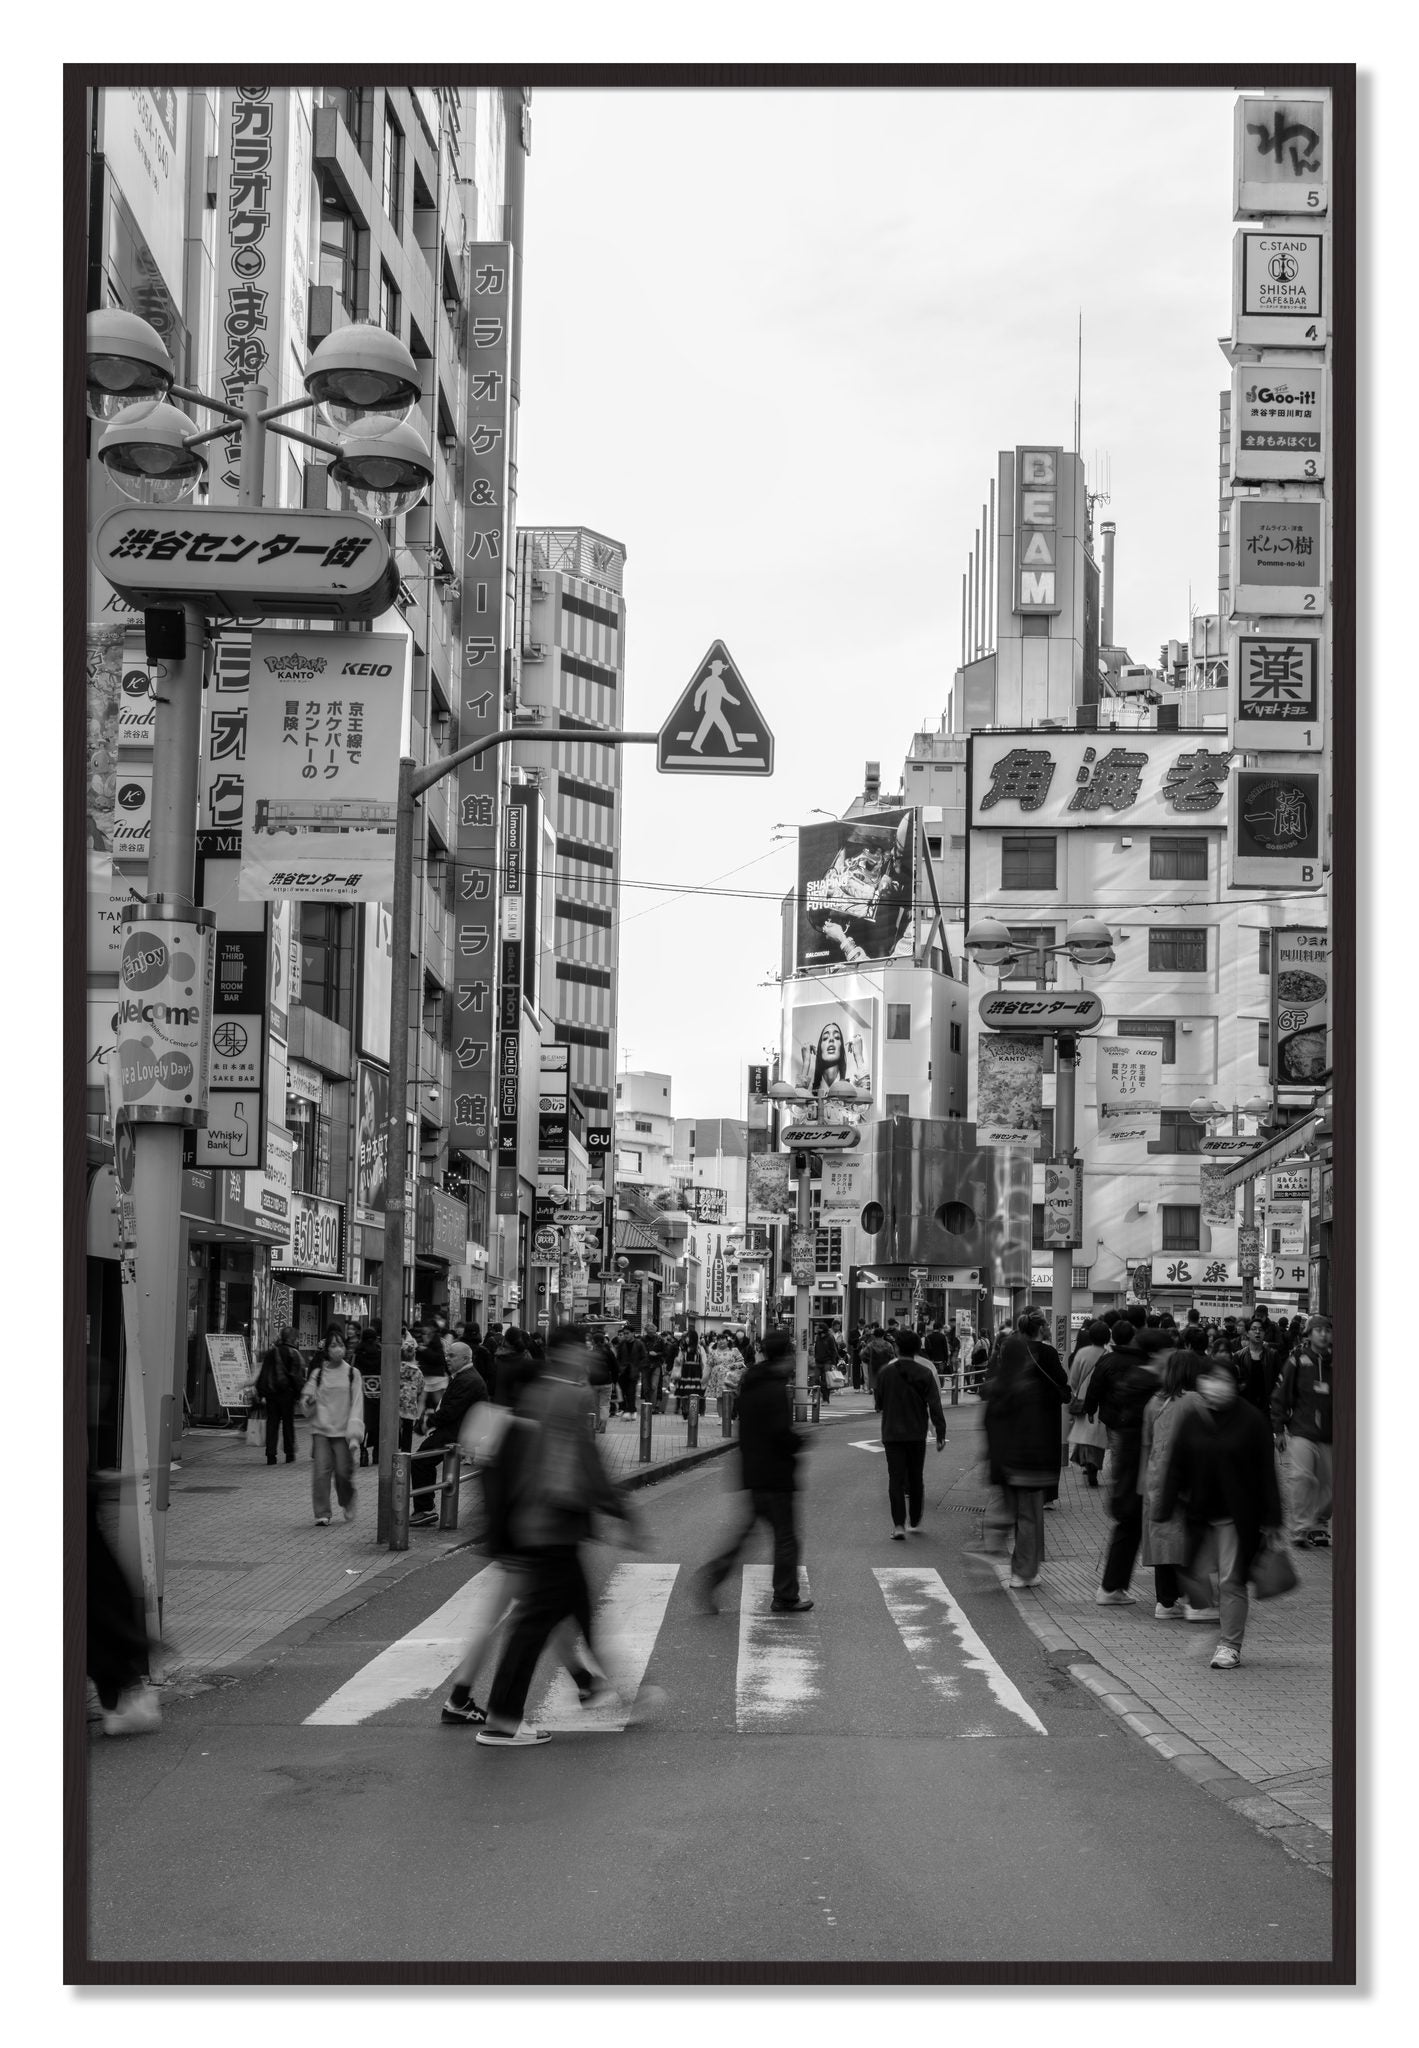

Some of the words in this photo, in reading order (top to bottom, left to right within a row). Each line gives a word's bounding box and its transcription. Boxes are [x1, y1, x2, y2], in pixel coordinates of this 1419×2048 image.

[230, 102, 272, 247] カラオケ
[1307, 191, 1319, 207] 5
[1260, 241, 1307, 251] C.STAND
[1259, 285, 1307, 296] SHISHA
[1305, 324, 1318, 341] 4
[1258, 386, 1316, 405] Goo-it!
[1250, 409, 1312, 418] 渋谷宇田川町店
[1245, 435, 1317, 448] 全身もみほぐし
[1304, 459, 1317, 476] 3
[1021, 453, 1056, 604] BEAM
[109, 528, 373, 568] 渋谷センター街
[1257, 559, 1305, 567] Pomme-no-ki
[1303, 593, 1316, 610] 2
[277, 671, 315, 679] KANTO
[341, 662, 393, 677] KEIO
[1250, 645, 1303, 699] 薬
[1243, 703, 1309, 718] マツモトキヨシ
[282, 701, 300, 746] 冒険へ
[123, 730, 150, 739] 渋谷店
[301, 701, 321, 779] カントーの
[323, 700, 343, 780] ポケパーク
[346, 702, 365, 765] 京王線で
[1303, 729, 1312, 746] 1
[510, 810, 519, 848] kimono
[119, 843, 145, 853] 渋谷店
[508, 853, 518, 889] hearts
[1301, 865, 1314, 882] B
[268, 873, 363, 887] 渋谷センター街
[221, 952, 245, 961] THIRD
[225, 944, 241, 953] THE
[122, 946, 165, 984] Enjoy
[220, 982, 243, 990] ROOM
[224, 994, 239, 1002] BAR
[119, 999, 199, 1026] Welcome
[987, 1000, 1093, 1015] 渋谷センター街
[1278, 1010, 1308, 1031] 6F
[136, 1060, 169, 1081] Lovely
[170, 1061, 191, 1077] Day!
[551, 1103, 565, 1111] UP
[208, 1130, 243, 1142] Whisky
[588, 1133, 610, 1145] GU
[784, 1130, 851, 1140] 渋谷センター街
[207, 1140, 229, 1149] Bank
[1166, 1260, 1229, 1283] 兆楽
[714, 1257, 723, 1303] BEER
